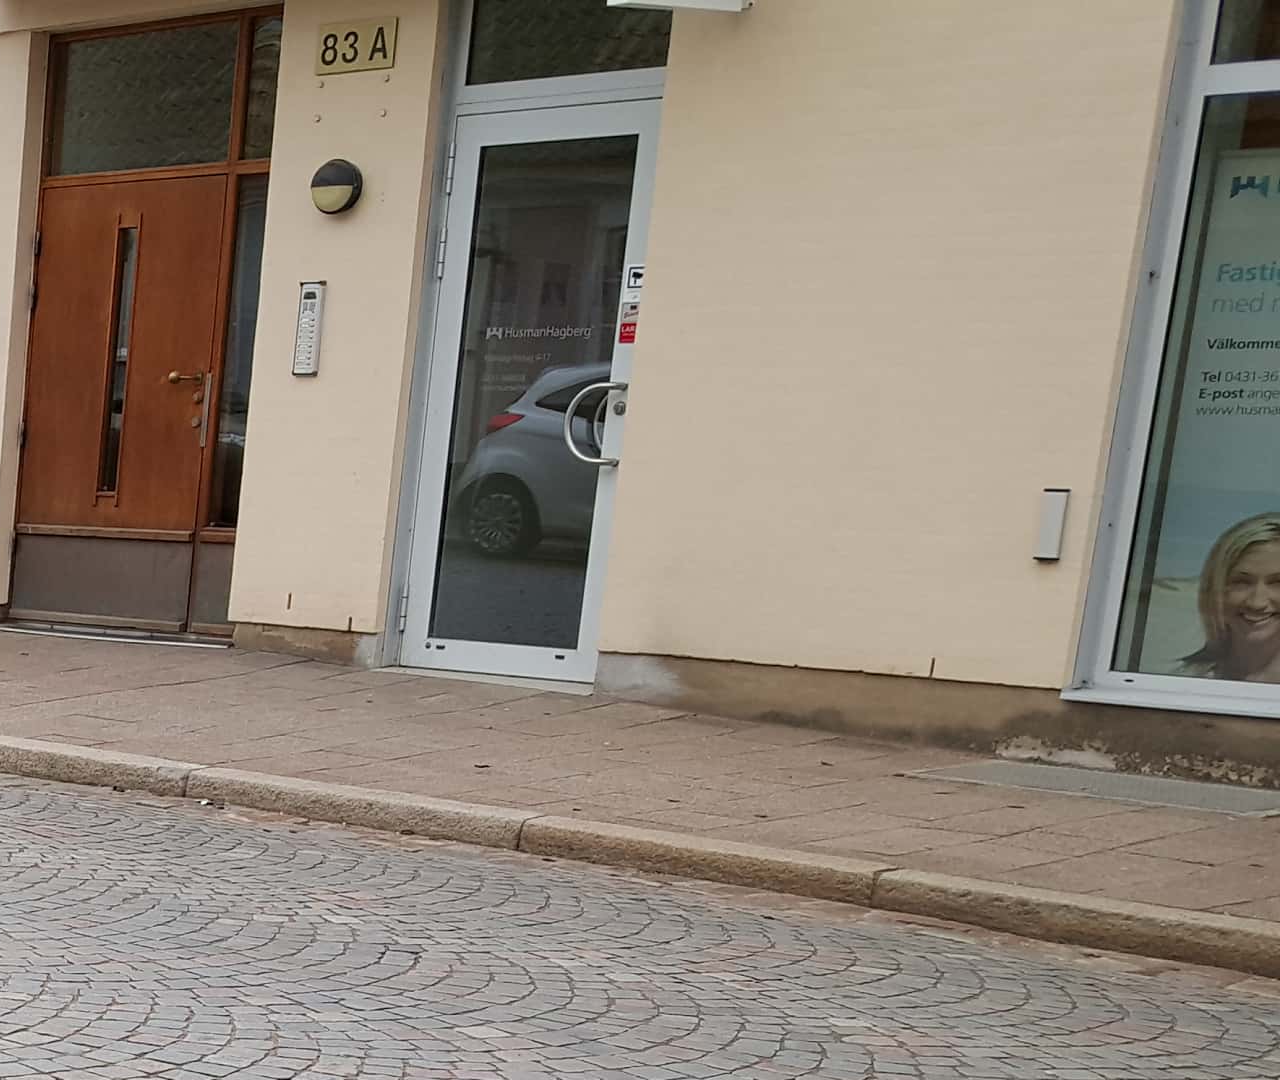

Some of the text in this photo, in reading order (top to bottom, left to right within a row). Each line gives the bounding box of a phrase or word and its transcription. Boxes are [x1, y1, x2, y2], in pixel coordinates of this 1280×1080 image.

[321, 26, 387, 65] 83 A
[1212, 292, 1265, 313] med
[504, 325, 592, 340] HusmanHagberg
[1207, 338, 1280, 350] Välkomme
[1202, 372, 1279, 382] Tel 0431-36
[1198, 388, 1245, 402] E-post
